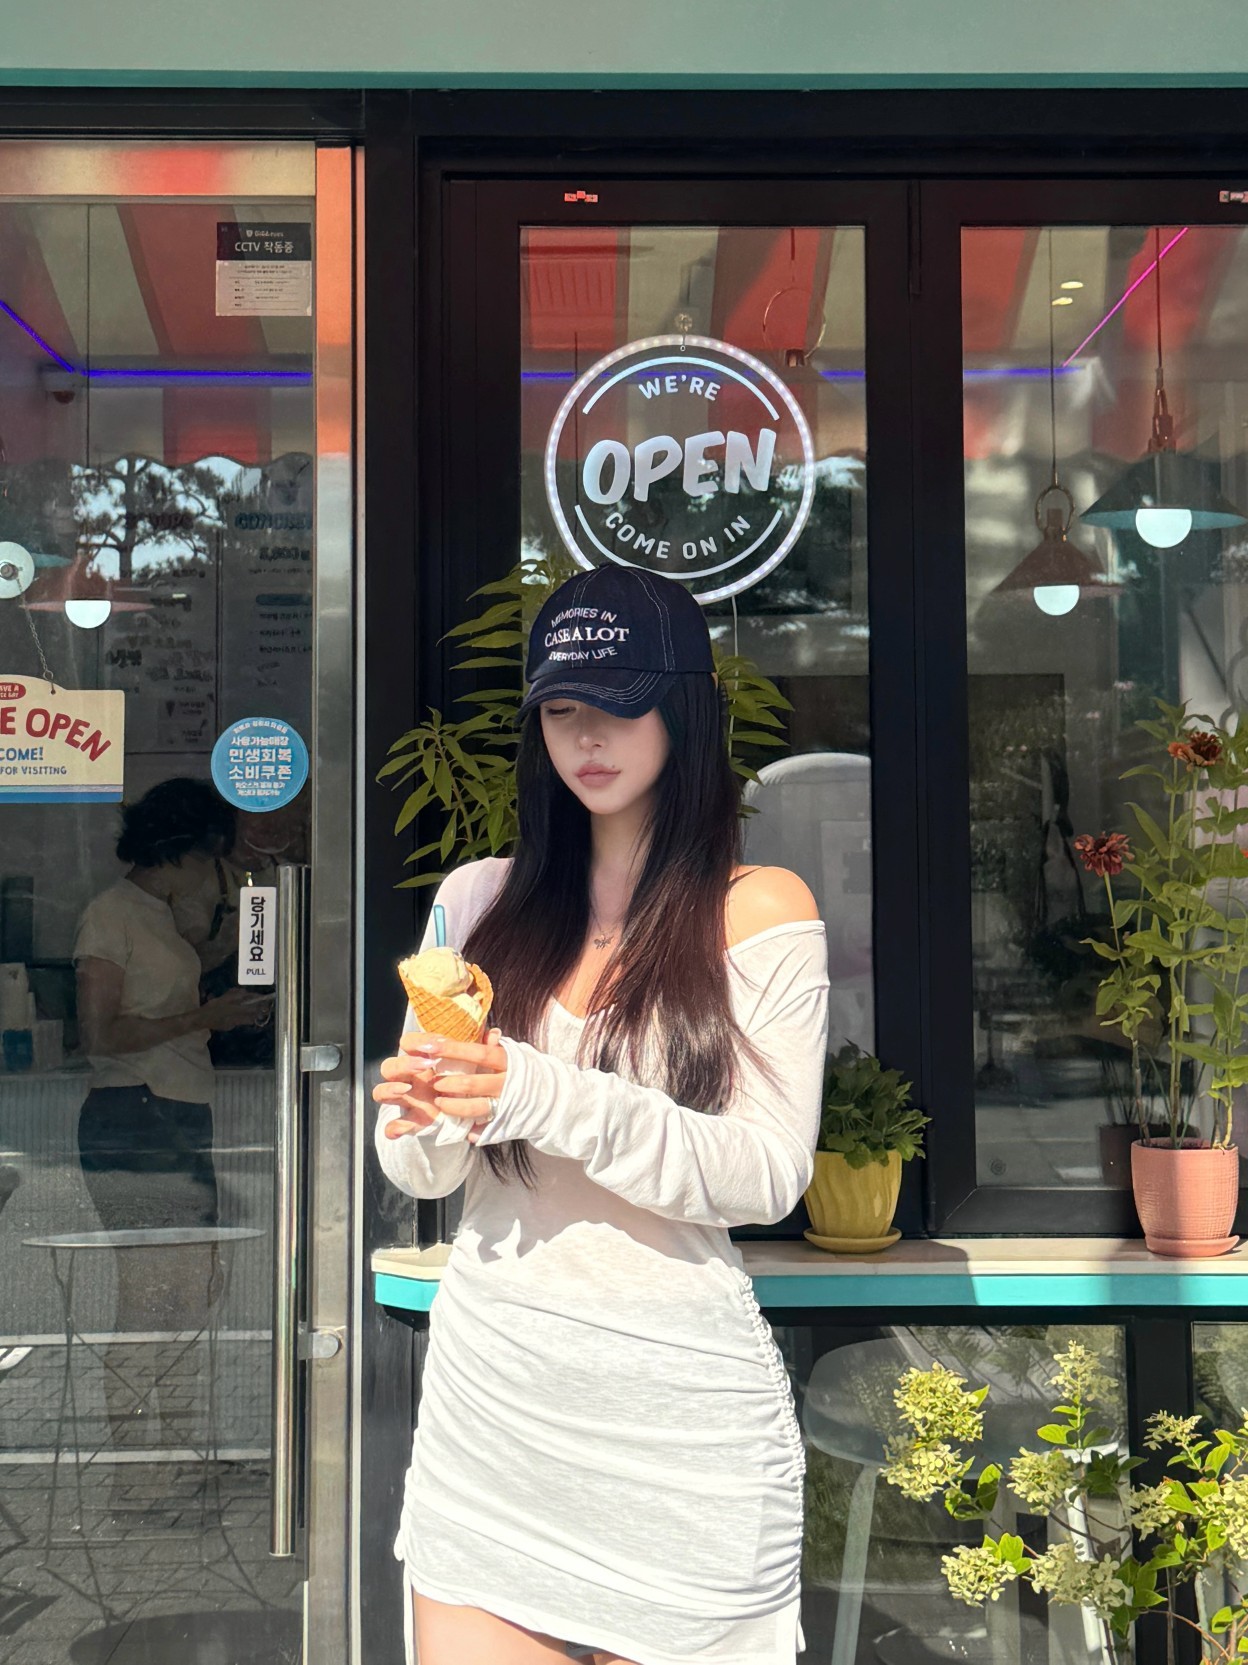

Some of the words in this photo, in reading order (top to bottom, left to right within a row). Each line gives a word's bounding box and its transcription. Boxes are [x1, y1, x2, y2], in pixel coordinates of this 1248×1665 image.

[234, 241, 261, 252] CCTV
[264, 241, 294, 254] 작동중
[638, 374, 722, 402] WE'RE
[582, 427, 777, 506] OPEN
[605, 512, 672, 560] COME
[682, 536, 718, 560] ON
[724, 515, 751, 543] IN
[550, 607, 599, 628] MEMORIES
[600, 610, 618, 624] IN
[548, 650, 590, 662] EVERYDAY
[592, 646, 618, 660] LIFE
[26, 708, 112, 762] OPEN
[229, 748, 292, 763] 민생회복
[0, 766, 18, 776] FOR
[21, 766, 67, 776] VISITING
[229, 765, 292, 780] 소비쿠폰
[249, 896, 266, 962] 당기세요
[246, 968, 267, 976] PULL
